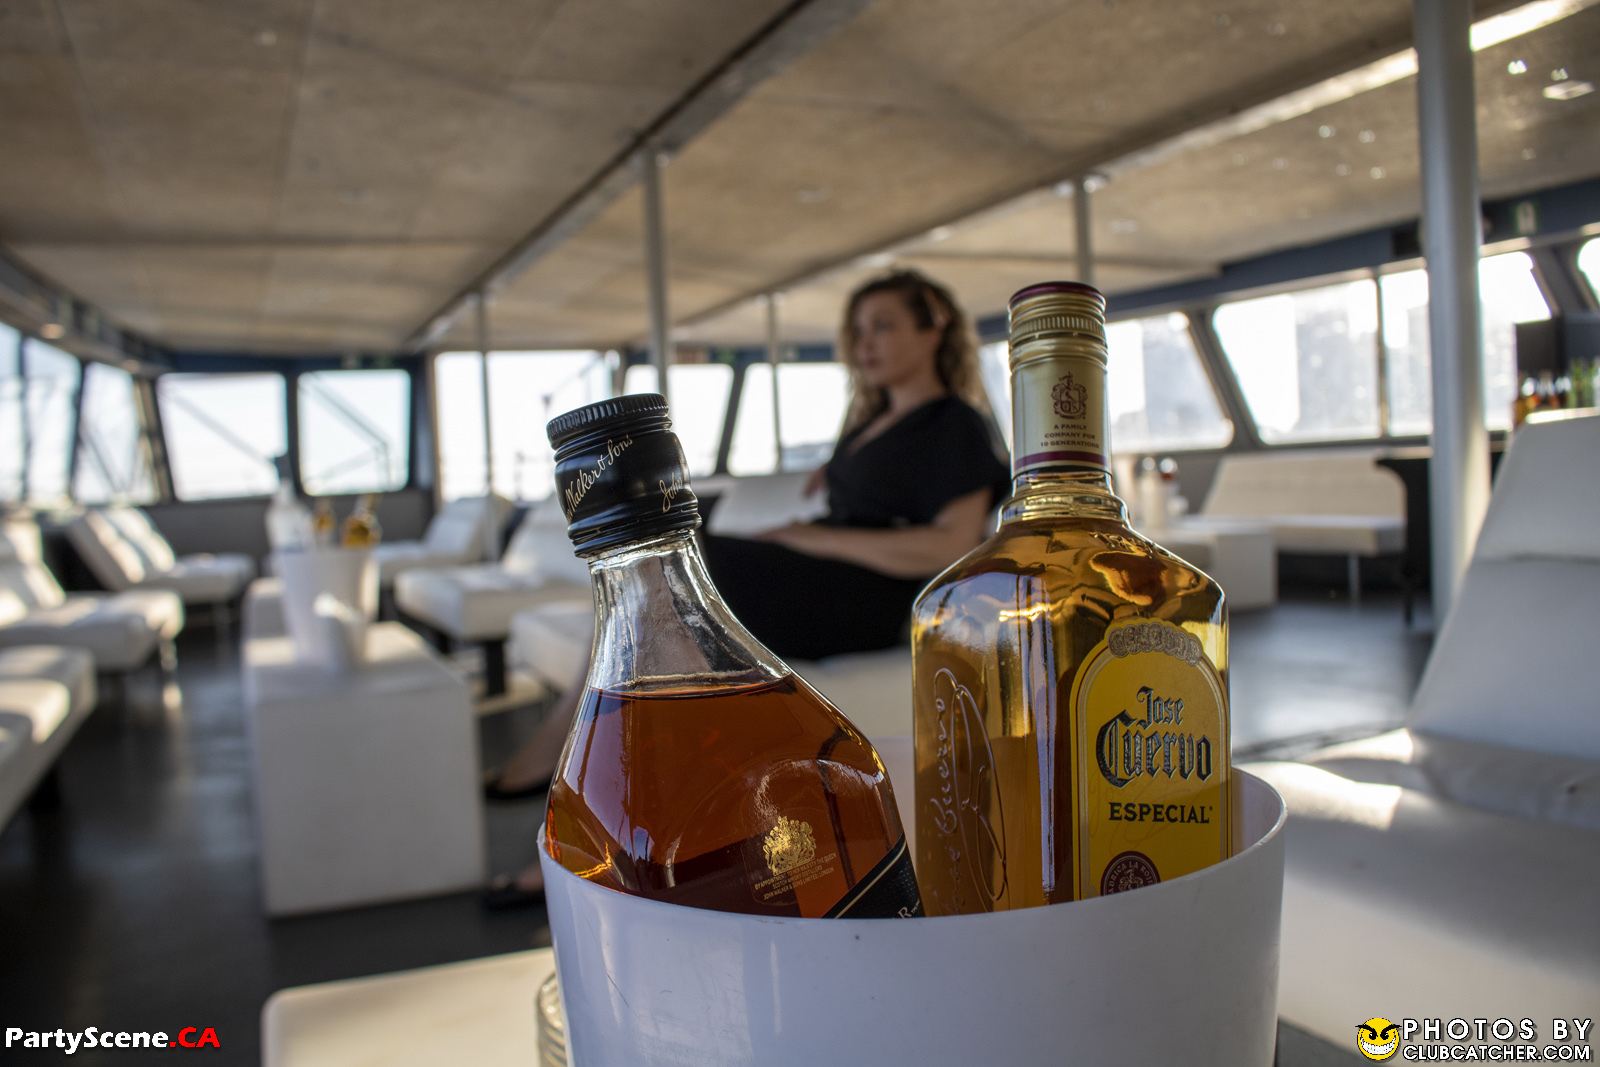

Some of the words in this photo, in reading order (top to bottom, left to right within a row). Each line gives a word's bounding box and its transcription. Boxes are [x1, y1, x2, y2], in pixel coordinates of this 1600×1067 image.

[1050, 441, 1099, 449] GENERATIONS
[563, 469, 602, 514] Walker
[659, 472, 683, 513] John
[1136, 685, 1184, 730] Jose
[1096, 709, 1212, 788] Cuervo
[1109, 802, 1210, 824] ESPECIAL
